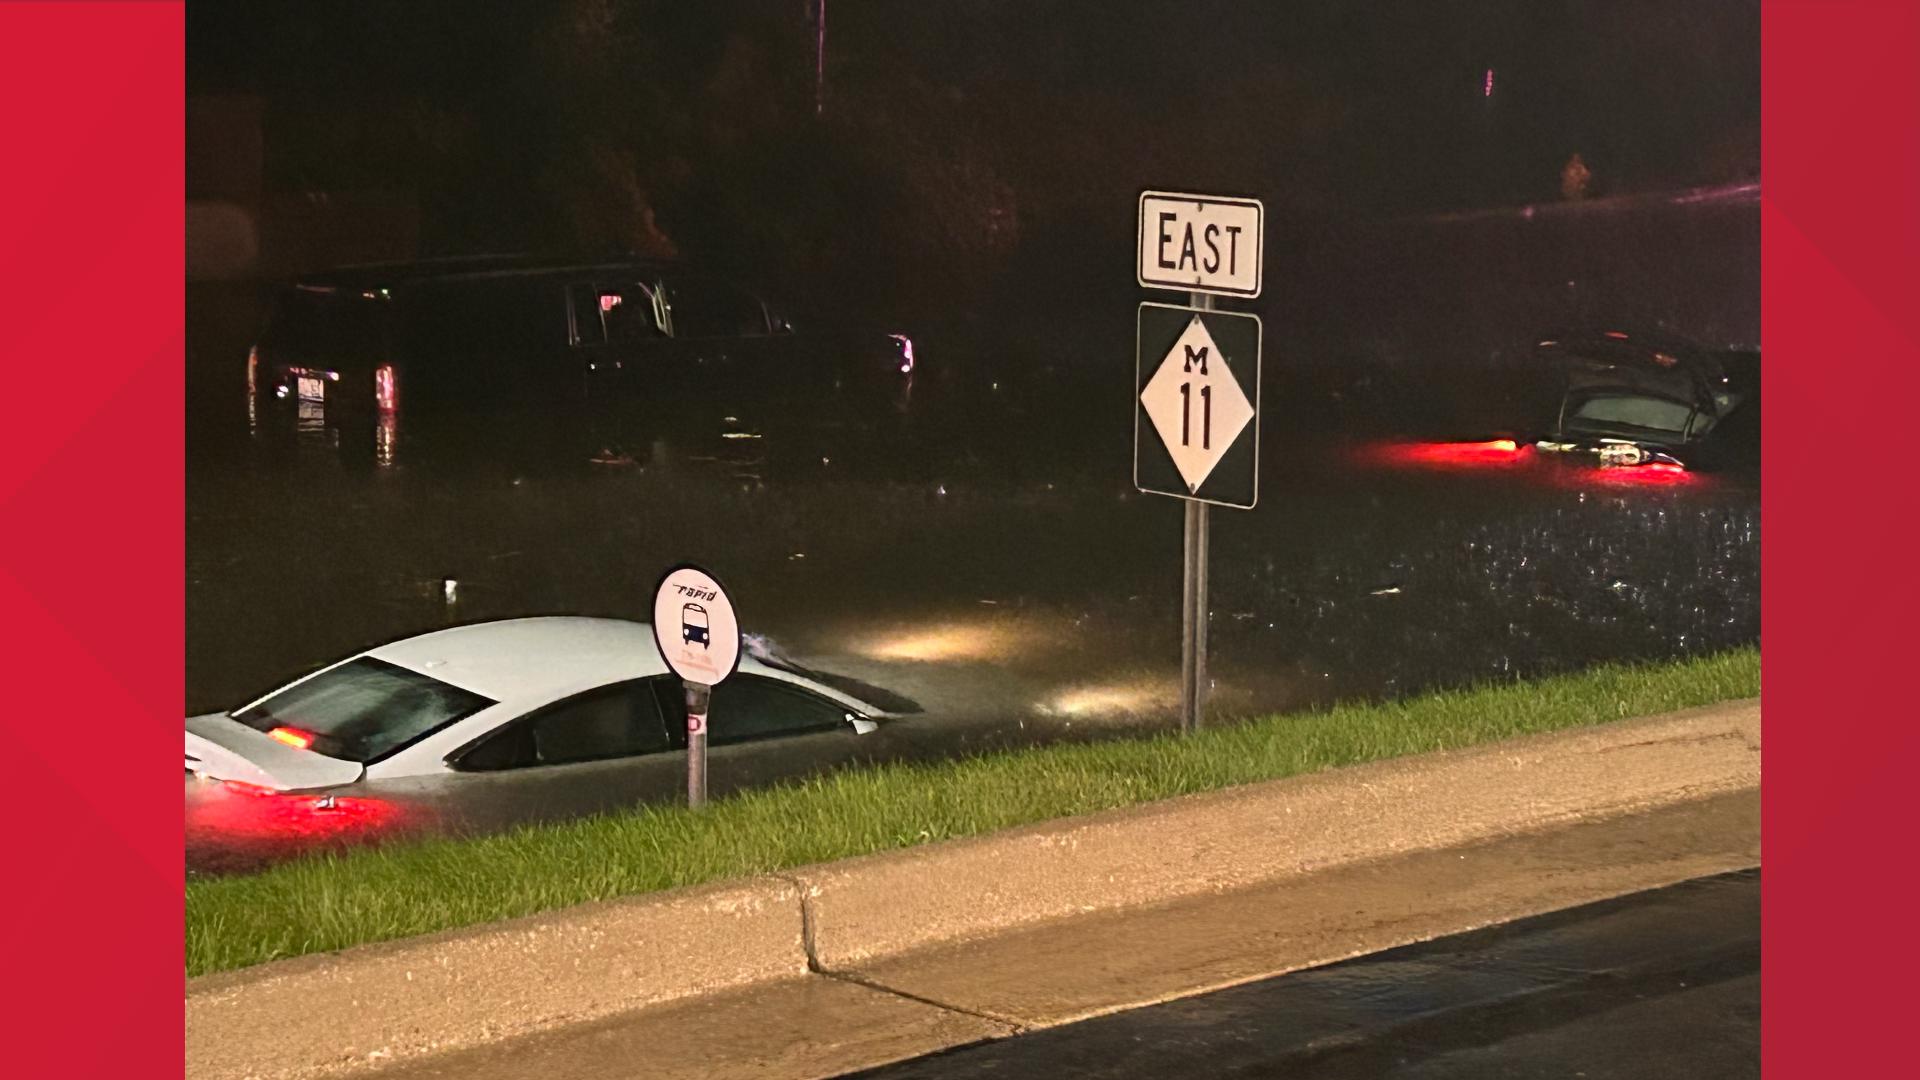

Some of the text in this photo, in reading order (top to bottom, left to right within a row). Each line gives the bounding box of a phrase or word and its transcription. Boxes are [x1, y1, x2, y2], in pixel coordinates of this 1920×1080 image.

[1158, 212, 1242, 275] EAST
[1184, 344, 1208, 376] M
[1180, 382, 1211, 450] 11
[676, 585, 718, 602] rapid
